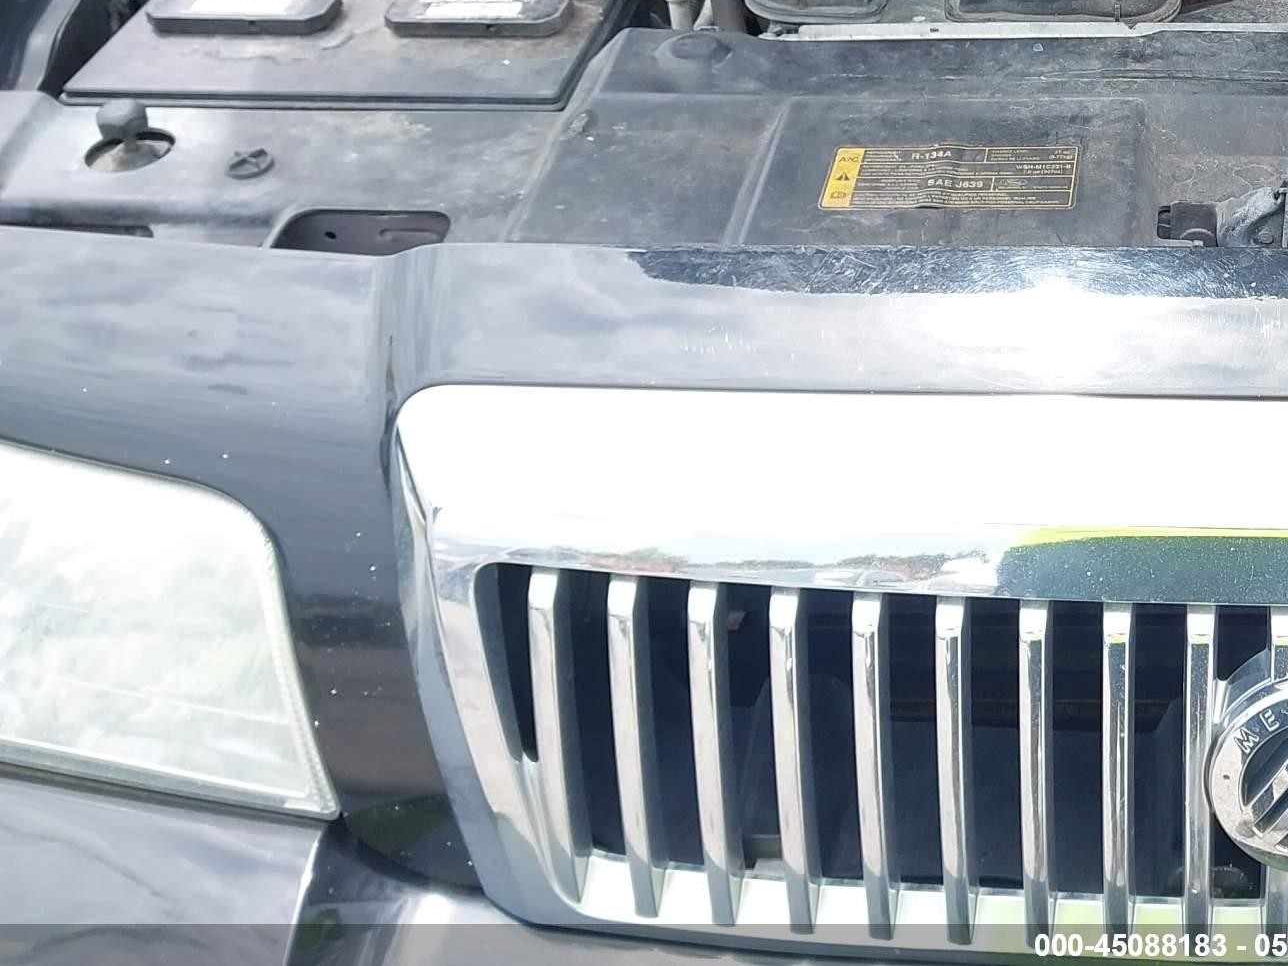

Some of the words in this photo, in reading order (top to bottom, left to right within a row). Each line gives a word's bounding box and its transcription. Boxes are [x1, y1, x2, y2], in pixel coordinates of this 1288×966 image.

[911, 150, 952, 160] R-134A
[927, 179, 953, 187] SAE
[955, 180, 984, 188] J639
